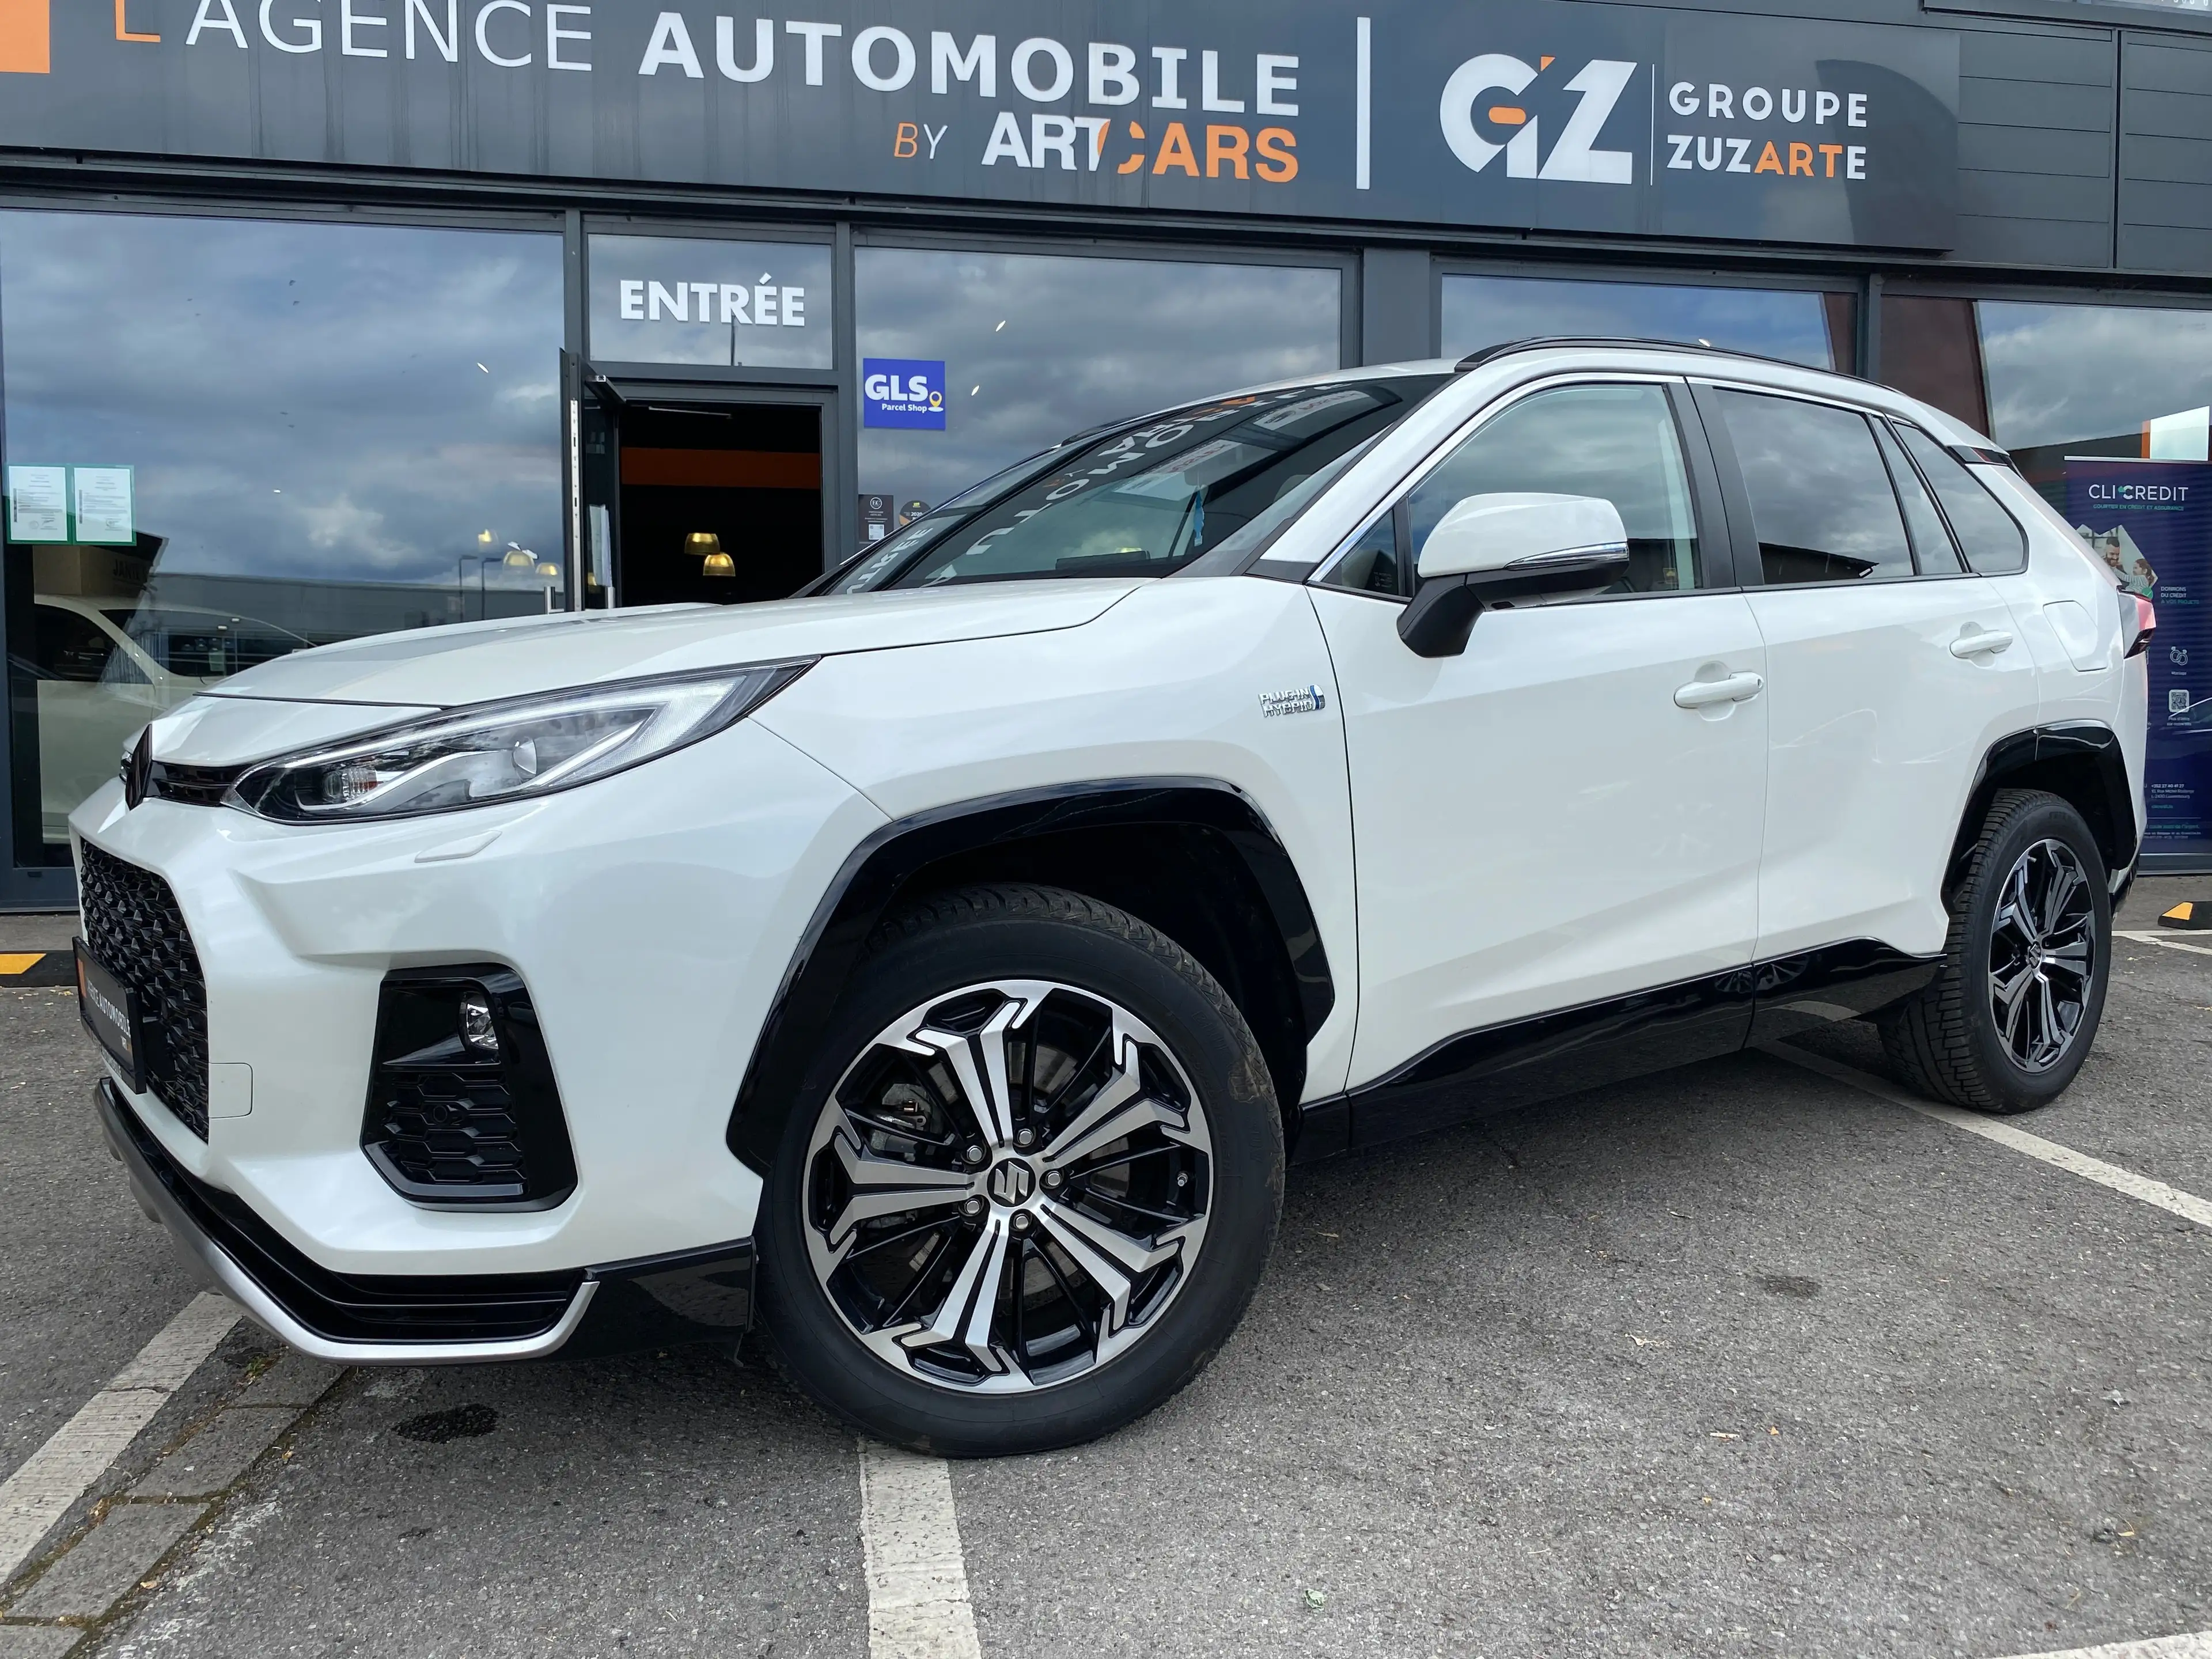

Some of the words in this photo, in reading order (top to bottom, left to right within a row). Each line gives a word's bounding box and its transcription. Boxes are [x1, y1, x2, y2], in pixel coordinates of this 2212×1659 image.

[638, 11, 1300, 117] AUTOMOBILE
[1668, 82, 1868, 128] GROUPE
[893, 122, 948, 160] BY
[1666, 134, 1866, 181] ZUZARTE
[620, 272, 805, 327] ENTRÉE
[865, 374, 929, 402] GLS
[882, 403, 906, 411] Parcel
[908, 404, 927, 414] Shop
[1259, 688, 1309, 704] PLUG-IN
[1262, 700, 1313, 717] HYBRID
